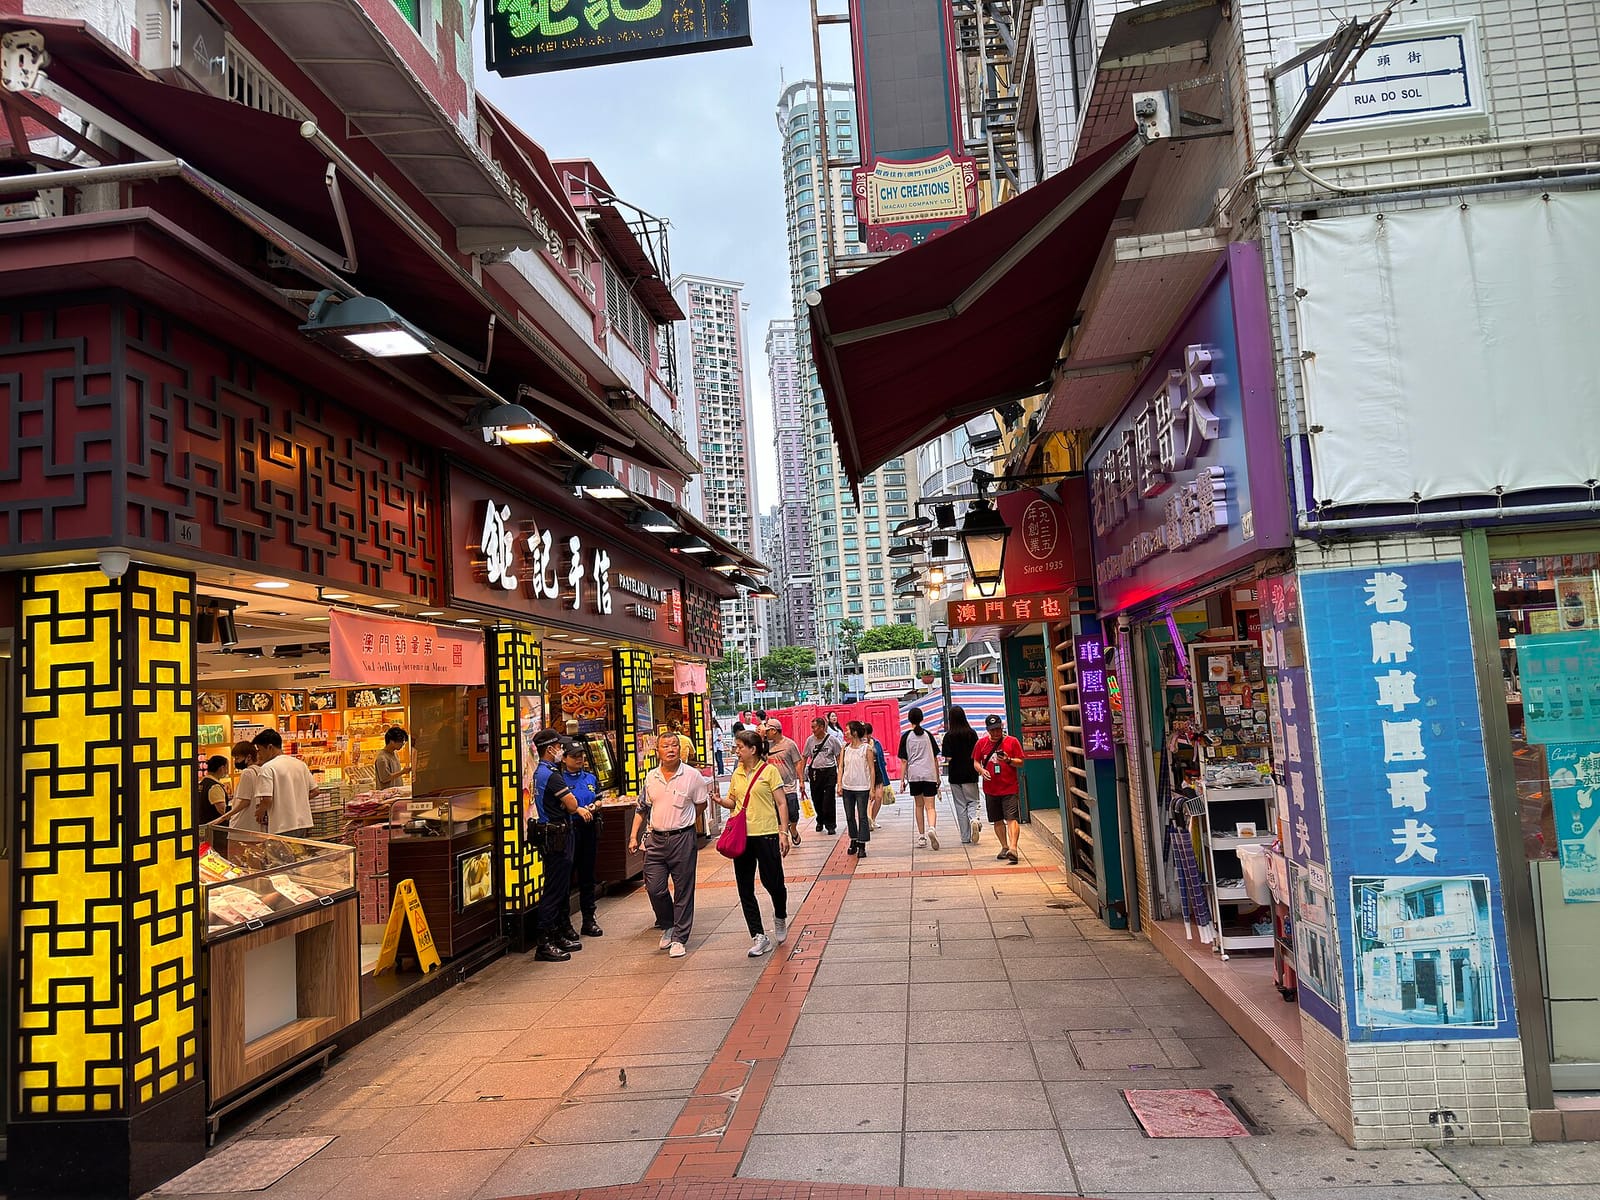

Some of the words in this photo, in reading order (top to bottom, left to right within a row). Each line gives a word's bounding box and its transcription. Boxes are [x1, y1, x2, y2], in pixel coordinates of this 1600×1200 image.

[1354, 94, 1377, 105] RUA
[1381, 91, 1396, 102] DO
[1401, 88, 1422, 99] SOL
[880, 186, 898, 201] CHY
[900, 181, 950, 199] CREATIONS
[908, 200, 938, 208] COMPANY
[180, 525, 192, 541] 46
[1038, 506, 1053, 551] 一九三五
[480, 499, 613, 615] 鉅記手信
[1023, 564, 1044, 575] Since
[1044, 560, 1064, 571] 1935
[618, 572, 649, 599] PASTELARIA
[956, 597, 1062, 623] 澳門官也
[362, 632, 446, 656] 澳門銷量第一
